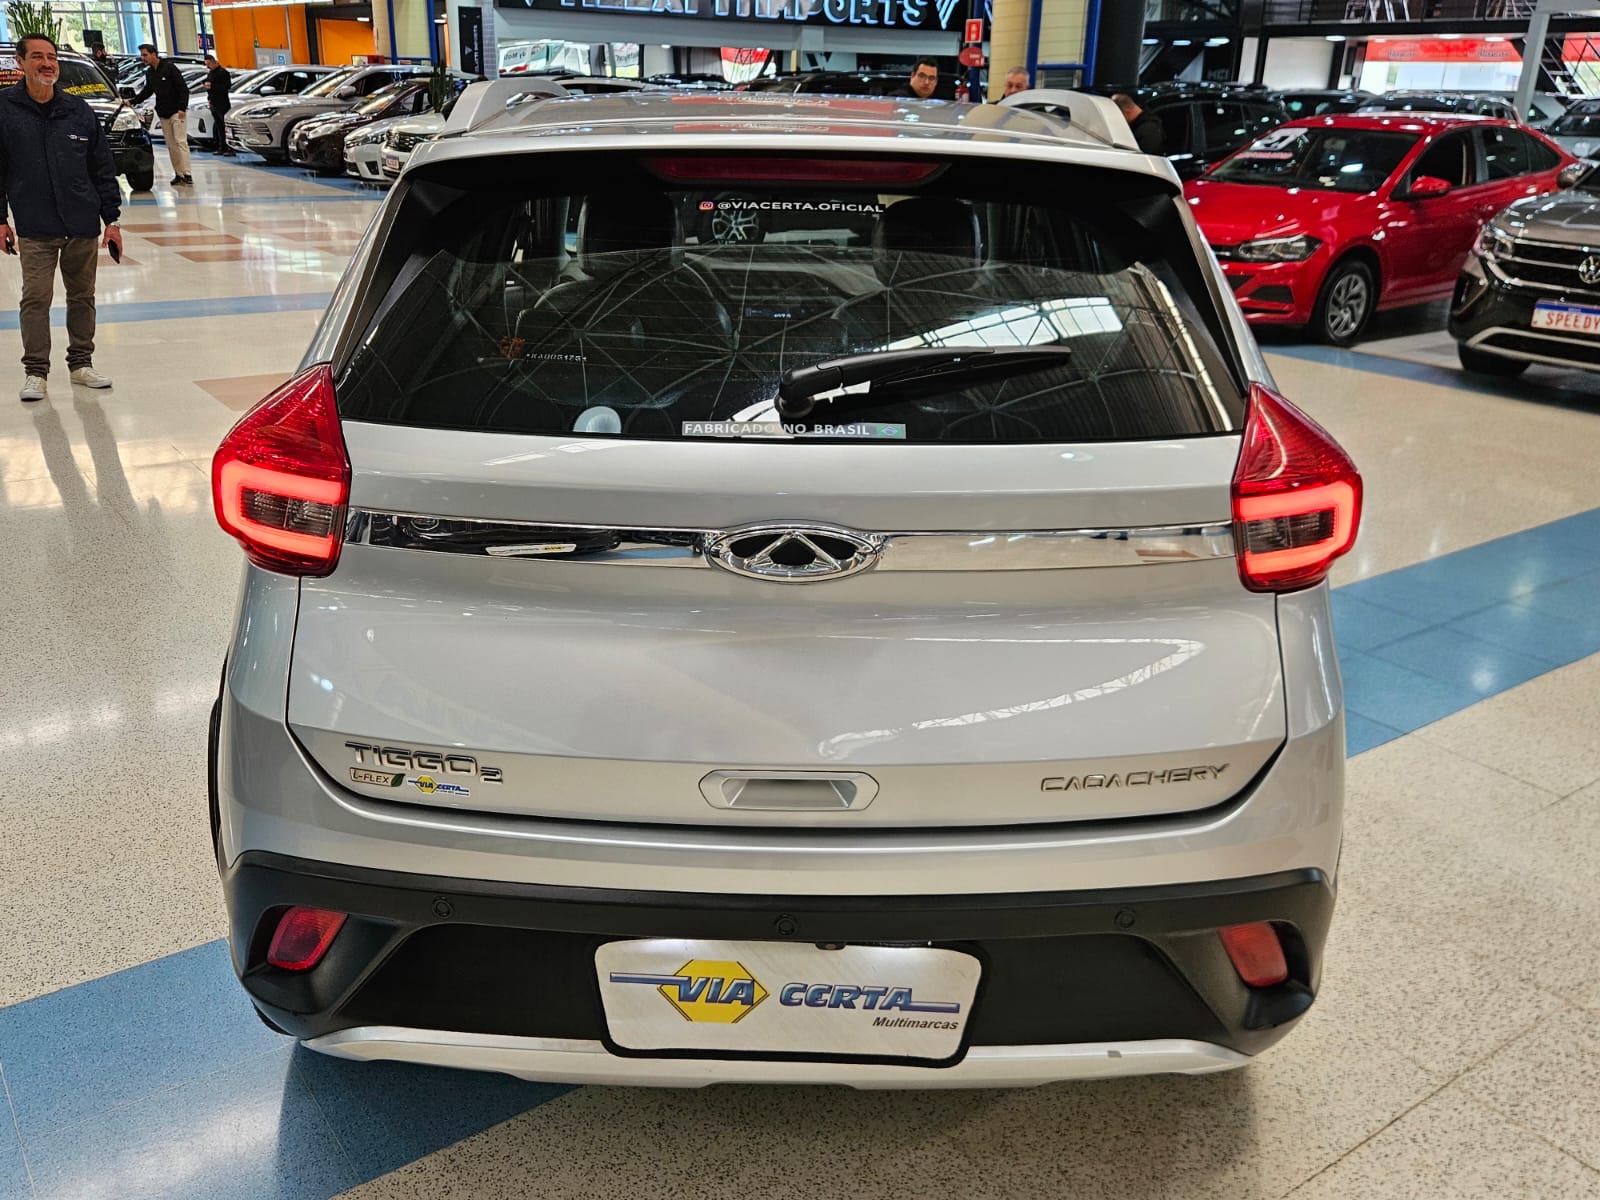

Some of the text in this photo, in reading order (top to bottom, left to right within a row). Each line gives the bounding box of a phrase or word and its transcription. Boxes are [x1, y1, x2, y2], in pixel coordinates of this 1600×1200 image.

[717, 201, 884, 213] @VIACERTA.OFICIAL
[684, 423, 870, 435] FABRICADO NO BRASIL
[352, 771, 390, 784] L-FLEX
[675, 976, 913, 1011] VIA CERTA
[871, 1016, 960, 1031] Multimarcas
